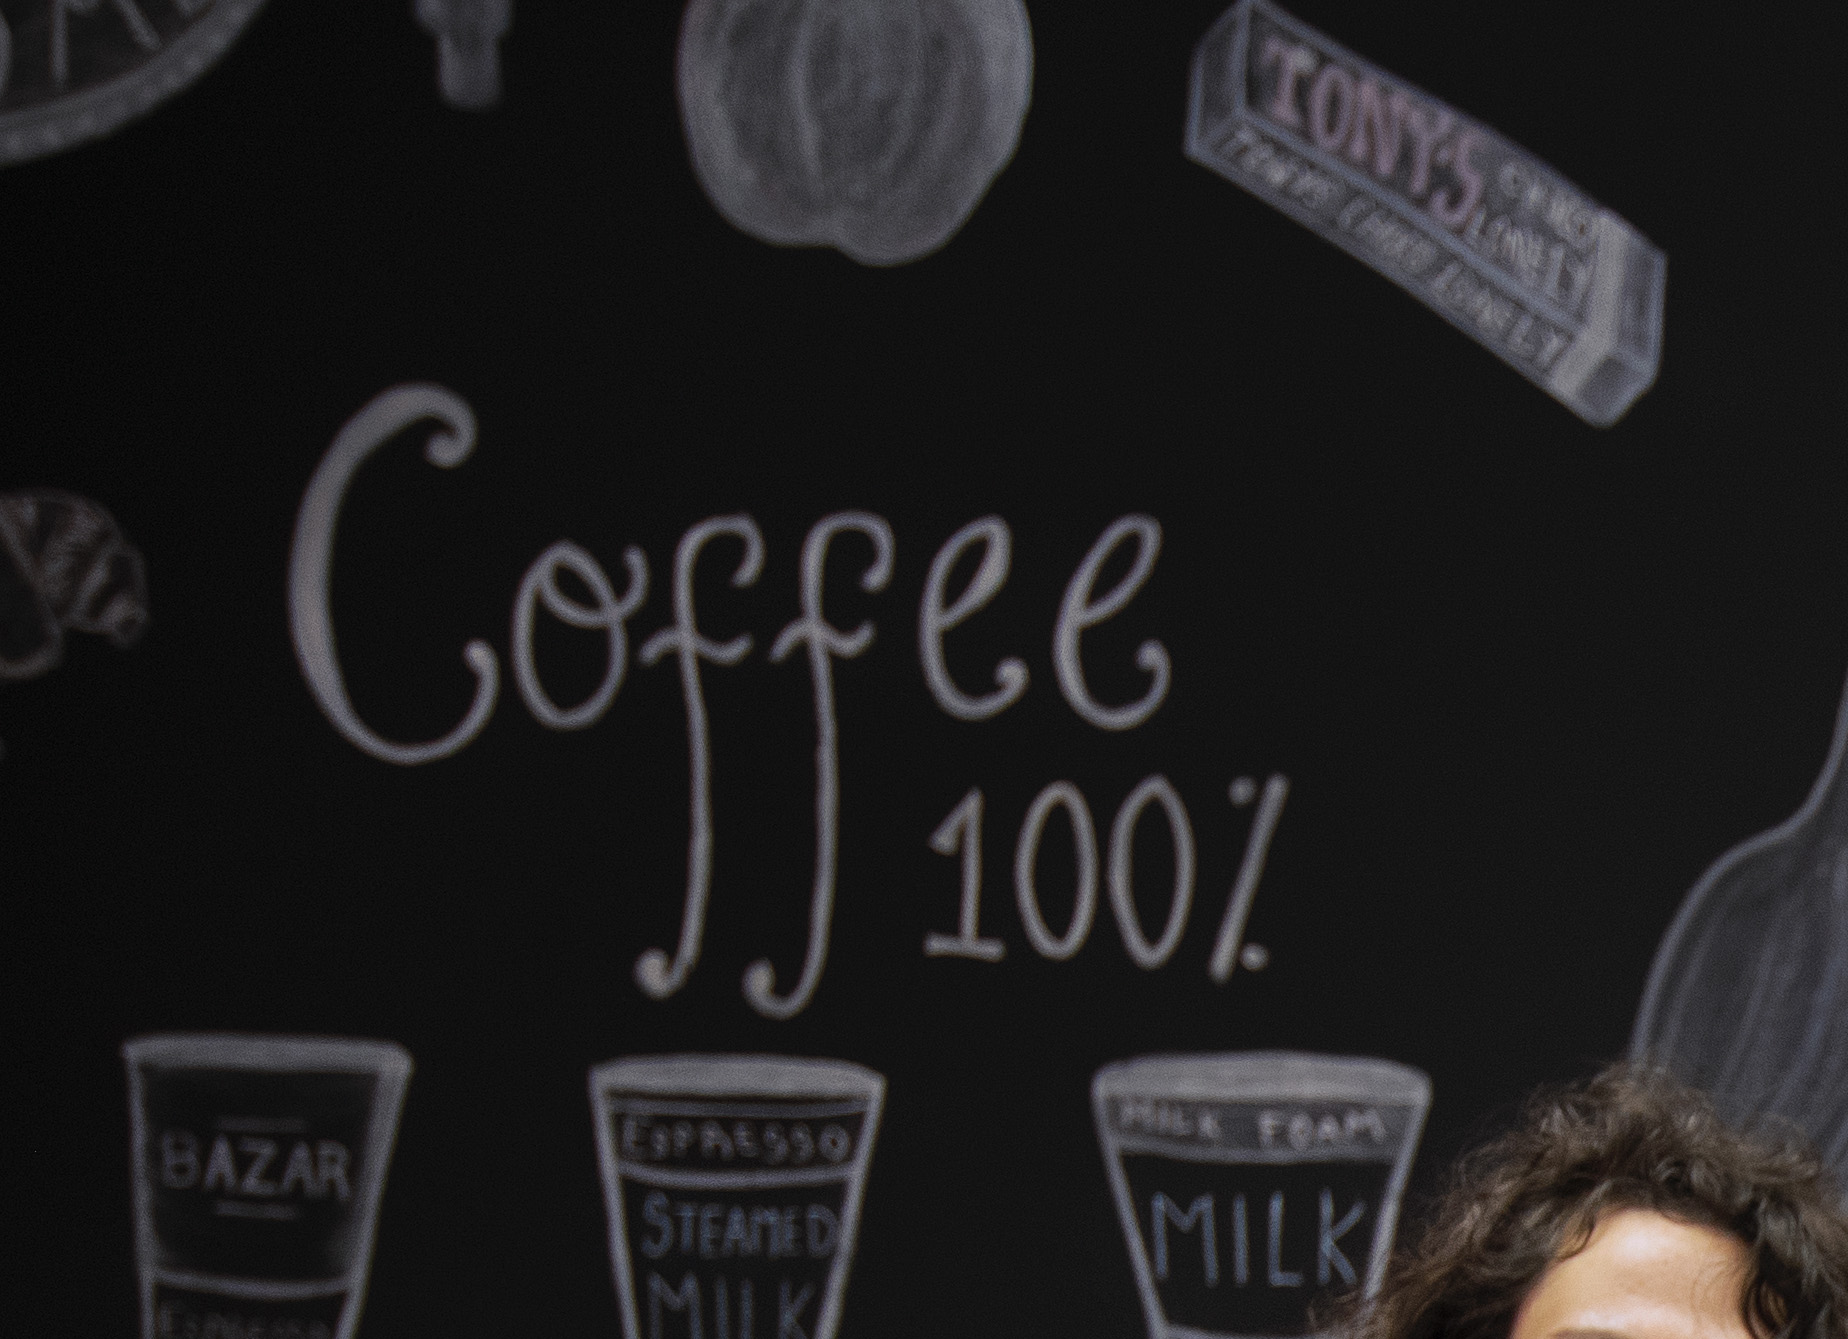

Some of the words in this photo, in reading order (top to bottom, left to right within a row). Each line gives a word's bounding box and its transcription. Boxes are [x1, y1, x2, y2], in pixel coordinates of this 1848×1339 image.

[287, 382, 1172, 1019] Coffee
[925, 773, 1290, 982] 100%
[160, 1130, 350, 1201] BAZAR
[1256, 1107, 1388, 1152] FOAM
[641, 1190, 840, 1260] STEAMED
[1150, 1187, 1368, 1289] MILK
